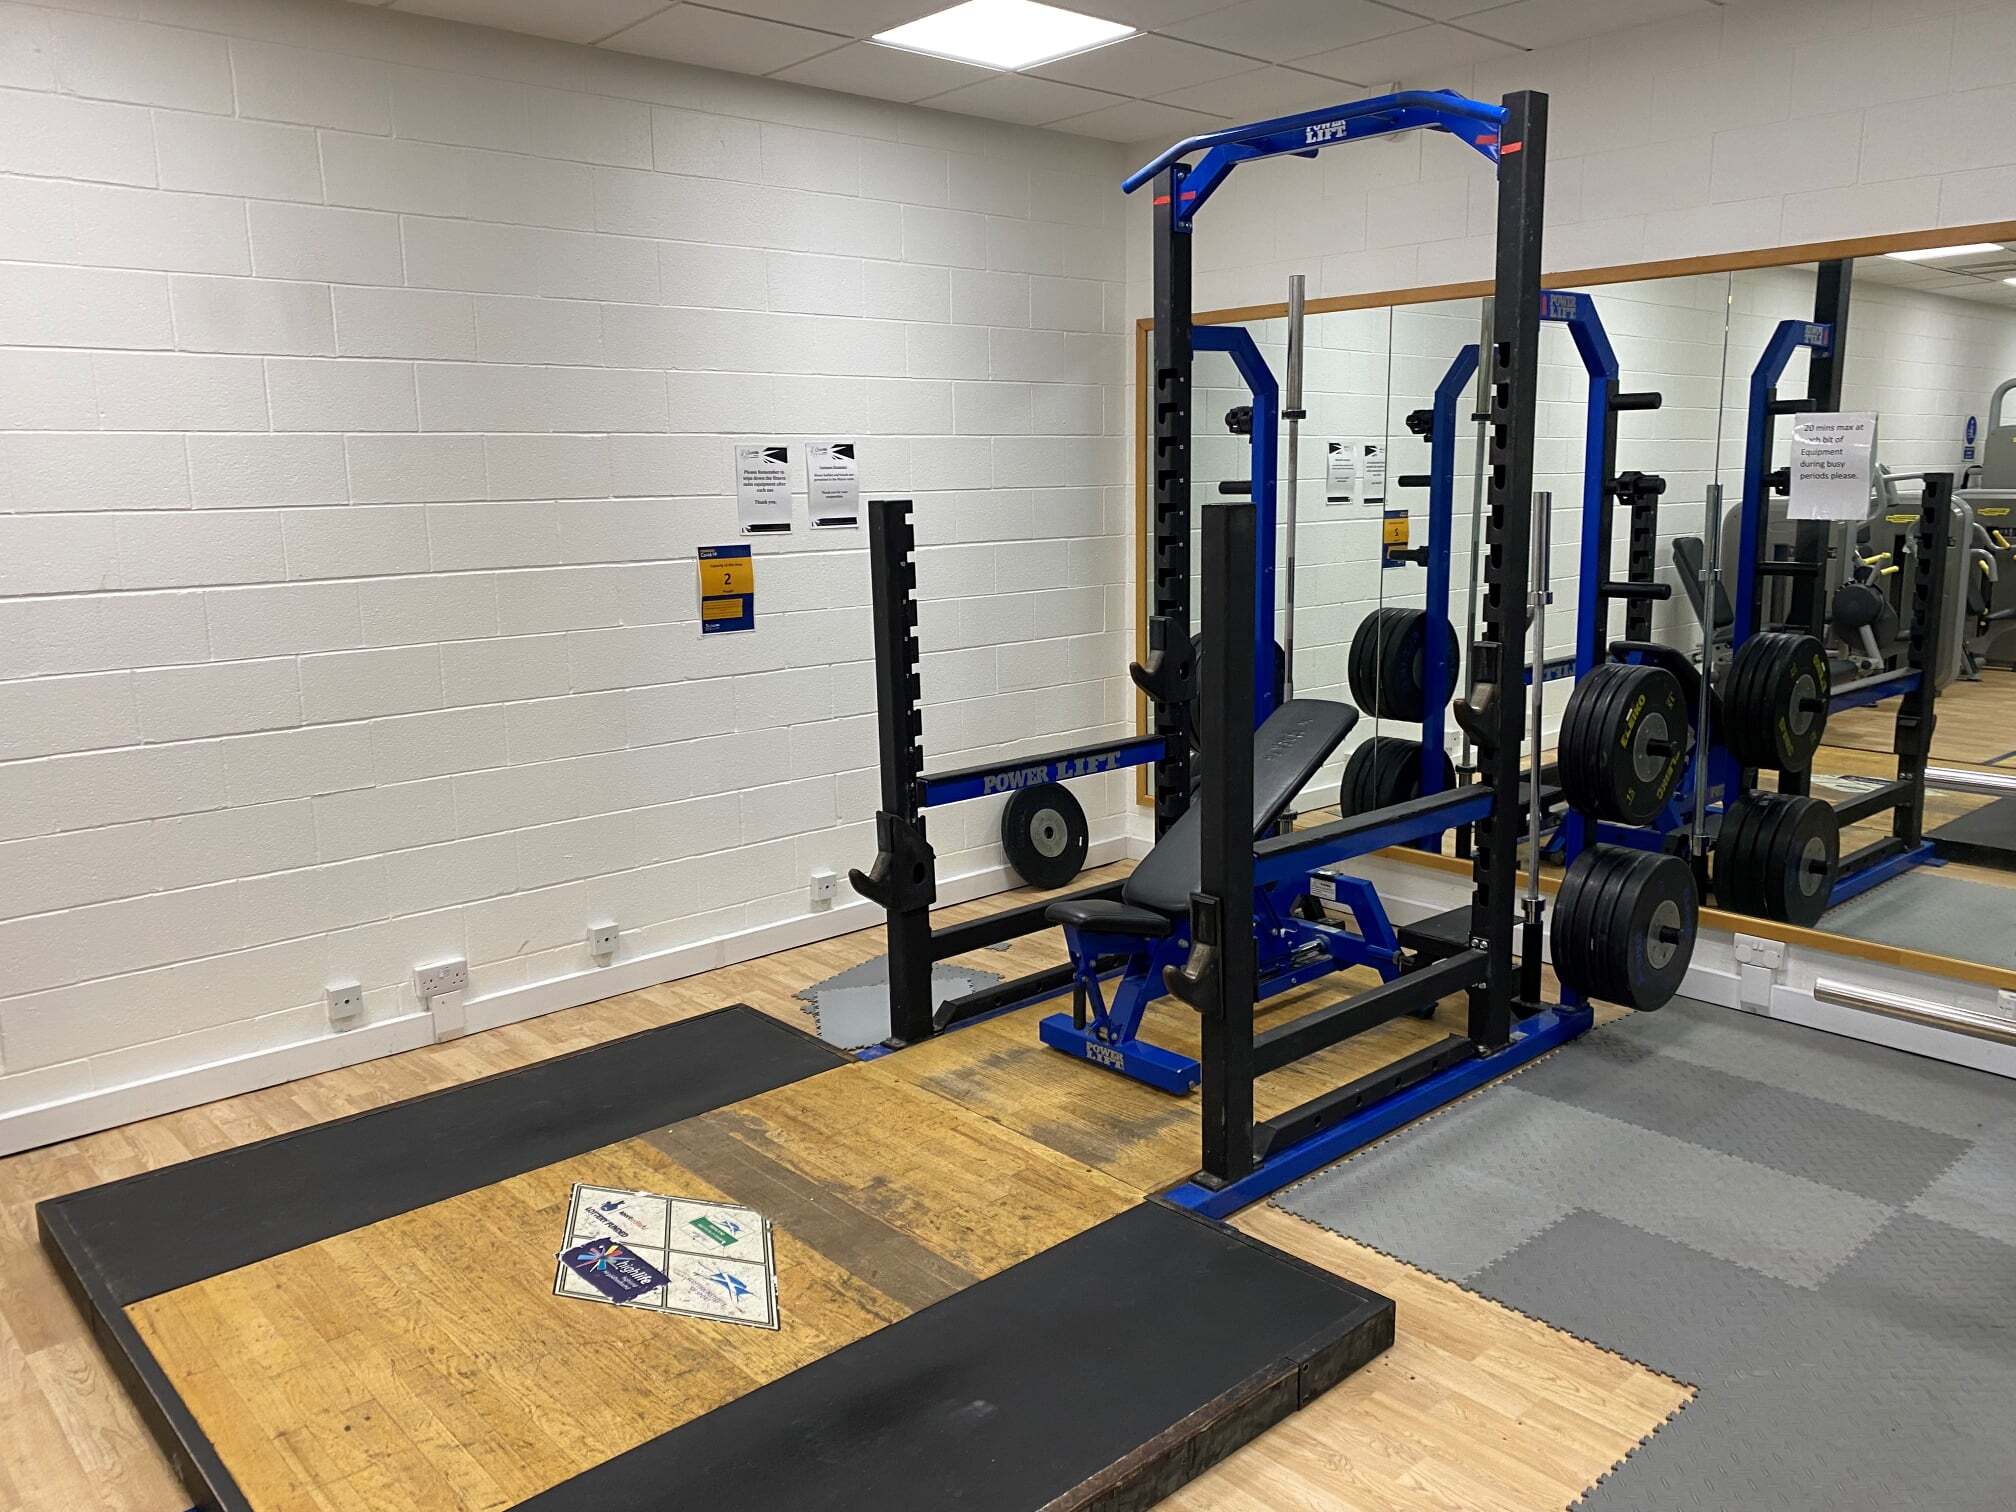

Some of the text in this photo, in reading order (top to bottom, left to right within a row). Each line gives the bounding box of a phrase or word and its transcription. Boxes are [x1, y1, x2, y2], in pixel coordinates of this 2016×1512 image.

[1306, 126, 1347, 144] LIFT
[1551, 294, 1576, 307] POWER
[1551, 304, 1576, 319] LIFT
[1801, 448, 1843, 456] Equipment
[1826, 460, 1846, 468] busy
[1800, 472, 1829, 480] periods
[724, 572, 732, 585] 2
[1621, 694, 1646, 748] ELEIKO
[984, 751, 1121, 794] POWER LIFT
[1086, 1041, 1124, 1061] POWER
[1086, 1050, 1125, 1070] LIFT
[584, 1206, 608, 1222] LOTTERY
[606, 1220, 630, 1237] FUNDED
[615, 1260, 653, 1285] highlife
